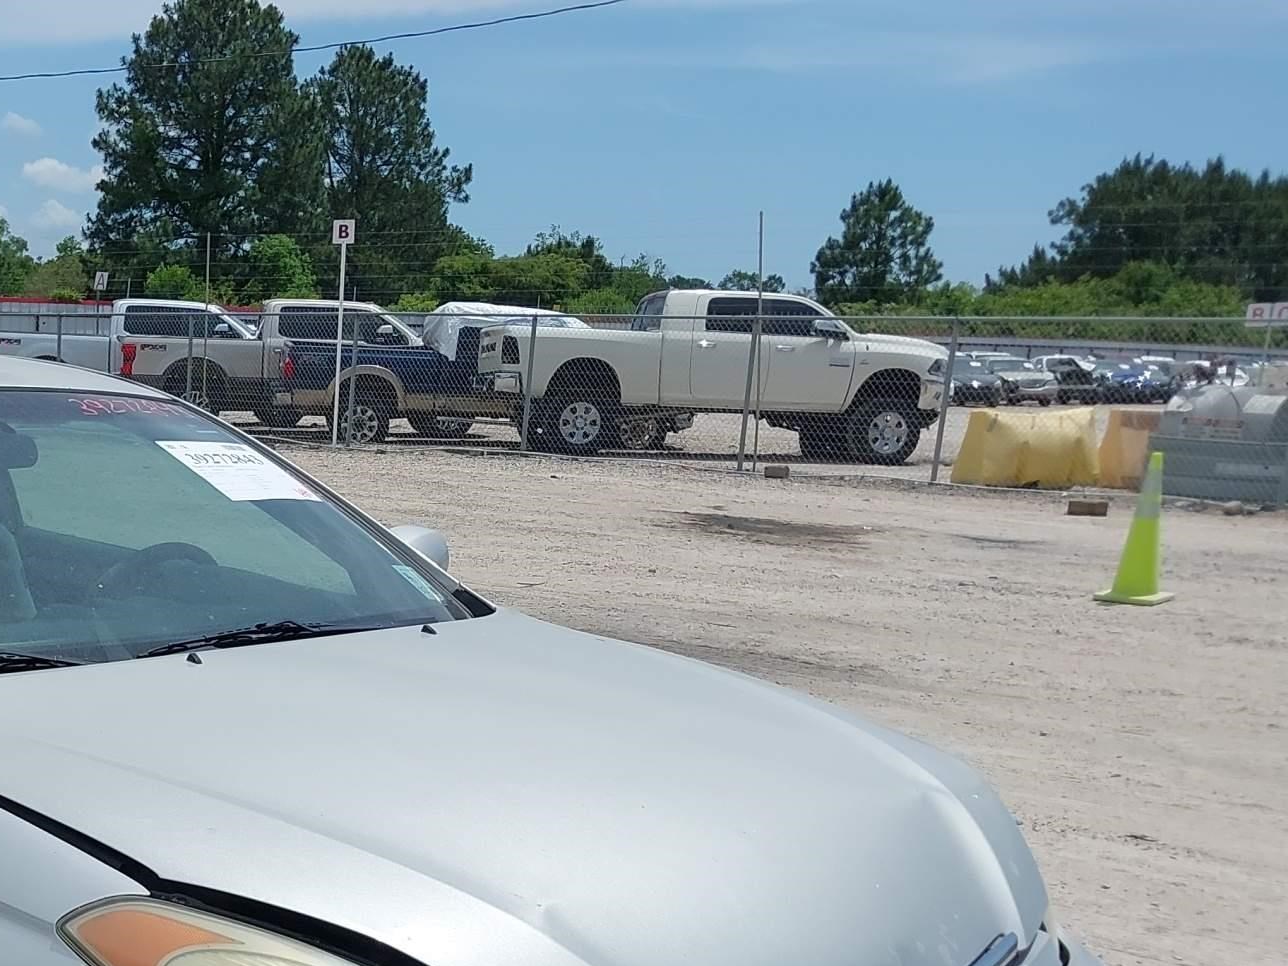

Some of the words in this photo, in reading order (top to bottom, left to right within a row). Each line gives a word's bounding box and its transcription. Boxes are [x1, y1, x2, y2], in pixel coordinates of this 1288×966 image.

[338, 223, 350, 239] B
[95, 272, 105, 289] A
[185, 452, 264, 465] 39272843
